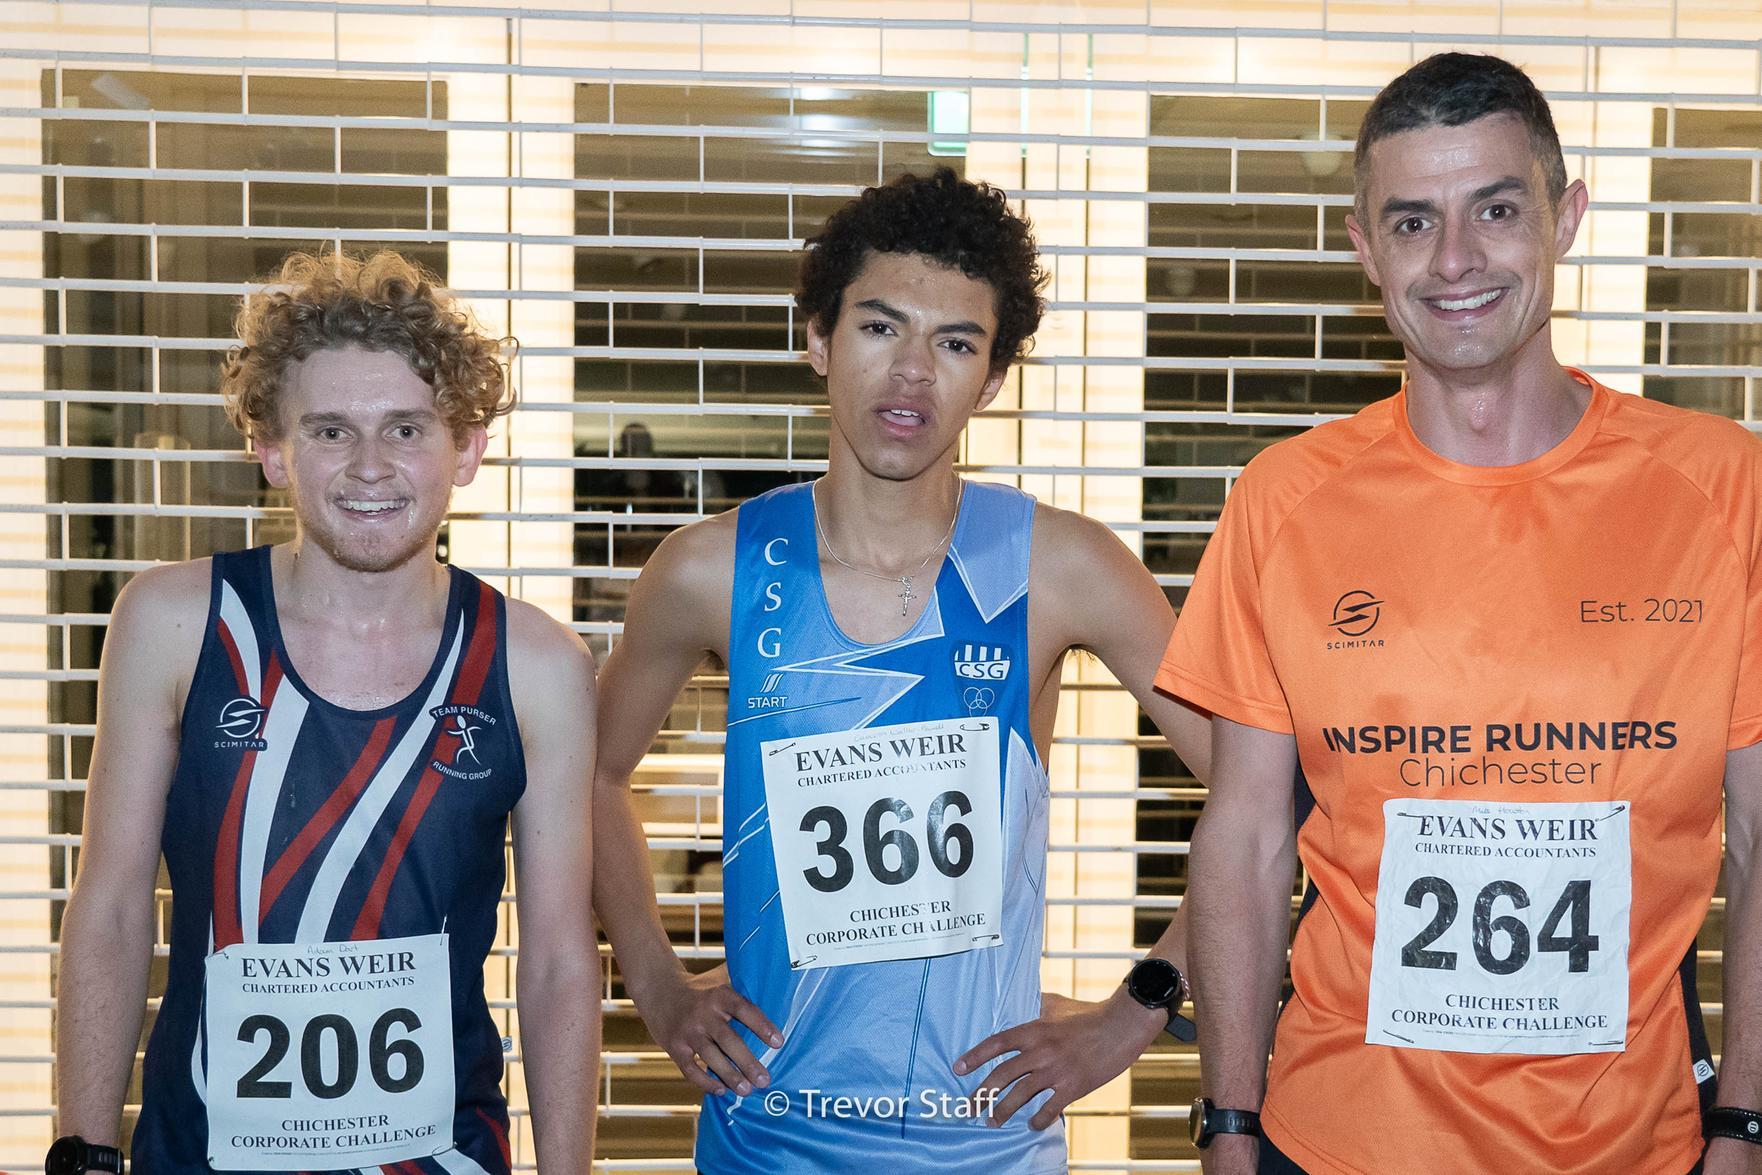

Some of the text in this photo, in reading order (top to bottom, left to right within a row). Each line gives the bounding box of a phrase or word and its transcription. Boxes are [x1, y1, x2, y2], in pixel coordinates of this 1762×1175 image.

[1581, 598, 1702, 623] Est. 2021
[1327, 639, 1385, 650] SCIMITAR
[959, 663, 1004, 679] CSG
[748, 696, 787, 709] START
[432, 706, 497, 726] TEAM PURSER
[214, 740, 264, 749] SCIMITAR
[1322, 721, 1678, 754] INSPIRE RUNNERS
[796, 733, 967, 772] EVANS WEIR
[432, 761, 492, 780] RUNNING GROUP
[797, 769, 872, 788] CHARTERED
[1399, 757, 1601, 787] Chichester
[1417, 815, 1599, 841] EVANS WEIR
[799, 791, 974, 893] 366
[1415, 842, 1596, 858] CHARTERED ACCOUNTANTS
[806, 925, 897, 946] CORPORATE
[1401, 876, 1599, 975] 264
[241, 951, 416, 978] EVANS WEIR
[242, 976, 415, 994] CHARTERED ACCOUNTANTS
[1445, 994, 1560, 1010] CHICHESTER
[1391, 1009, 1608, 1031] CORPORATE CHALLENGE
[236, 1008, 425, 1099] 206
[282, 1114, 390, 1132] CHICHESTER
[231, 1125, 436, 1149] CORPORATE CHALLENGE
